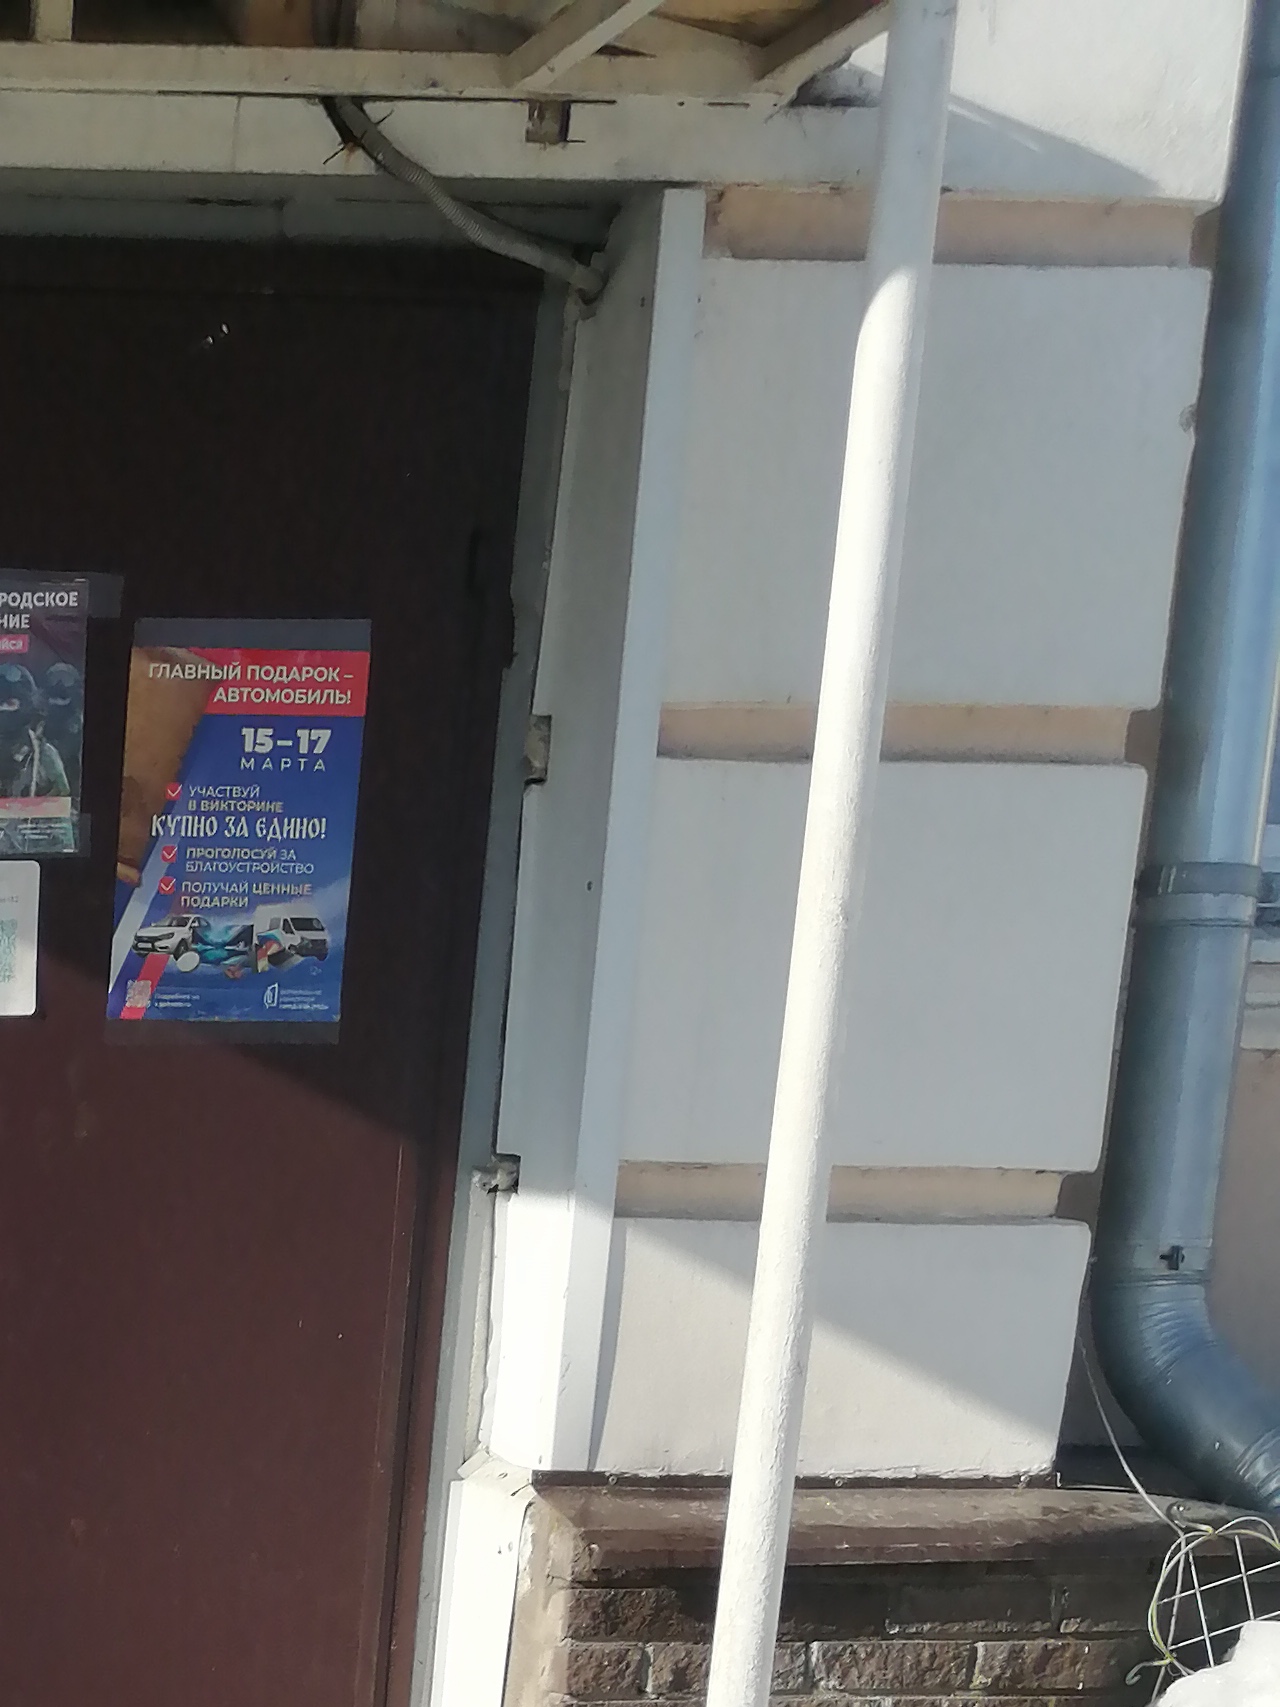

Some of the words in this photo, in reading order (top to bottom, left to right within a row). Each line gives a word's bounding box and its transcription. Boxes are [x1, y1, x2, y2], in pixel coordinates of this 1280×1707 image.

[149, 661, 241, 681] ГЛАВНЫЙ
[246, 665, 340, 685] ПОДАРОК
[213, 687, 352, 705] АВТОМОБИЛЬ!
[240, 757, 326, 772] МАРТА
[189, 784, 260, 798] УЧАСТВУЙ
[200, 801, 284, 813] ВИКТОРИНЕ
[151, 814, 218, 838] КУПНО
[224, 815, 249, 838] ЗА
[186, 846, 277, 860] ПРОГОЛОСУЙ
[280, 849, 297, 861] ЗА
[181, 880, 249, 894] ПОЛУЧАЙ
[252, 883, 313, 897] ЦЕННЫЕ
[180, 896, 249, 909] ПОДАРКИ
